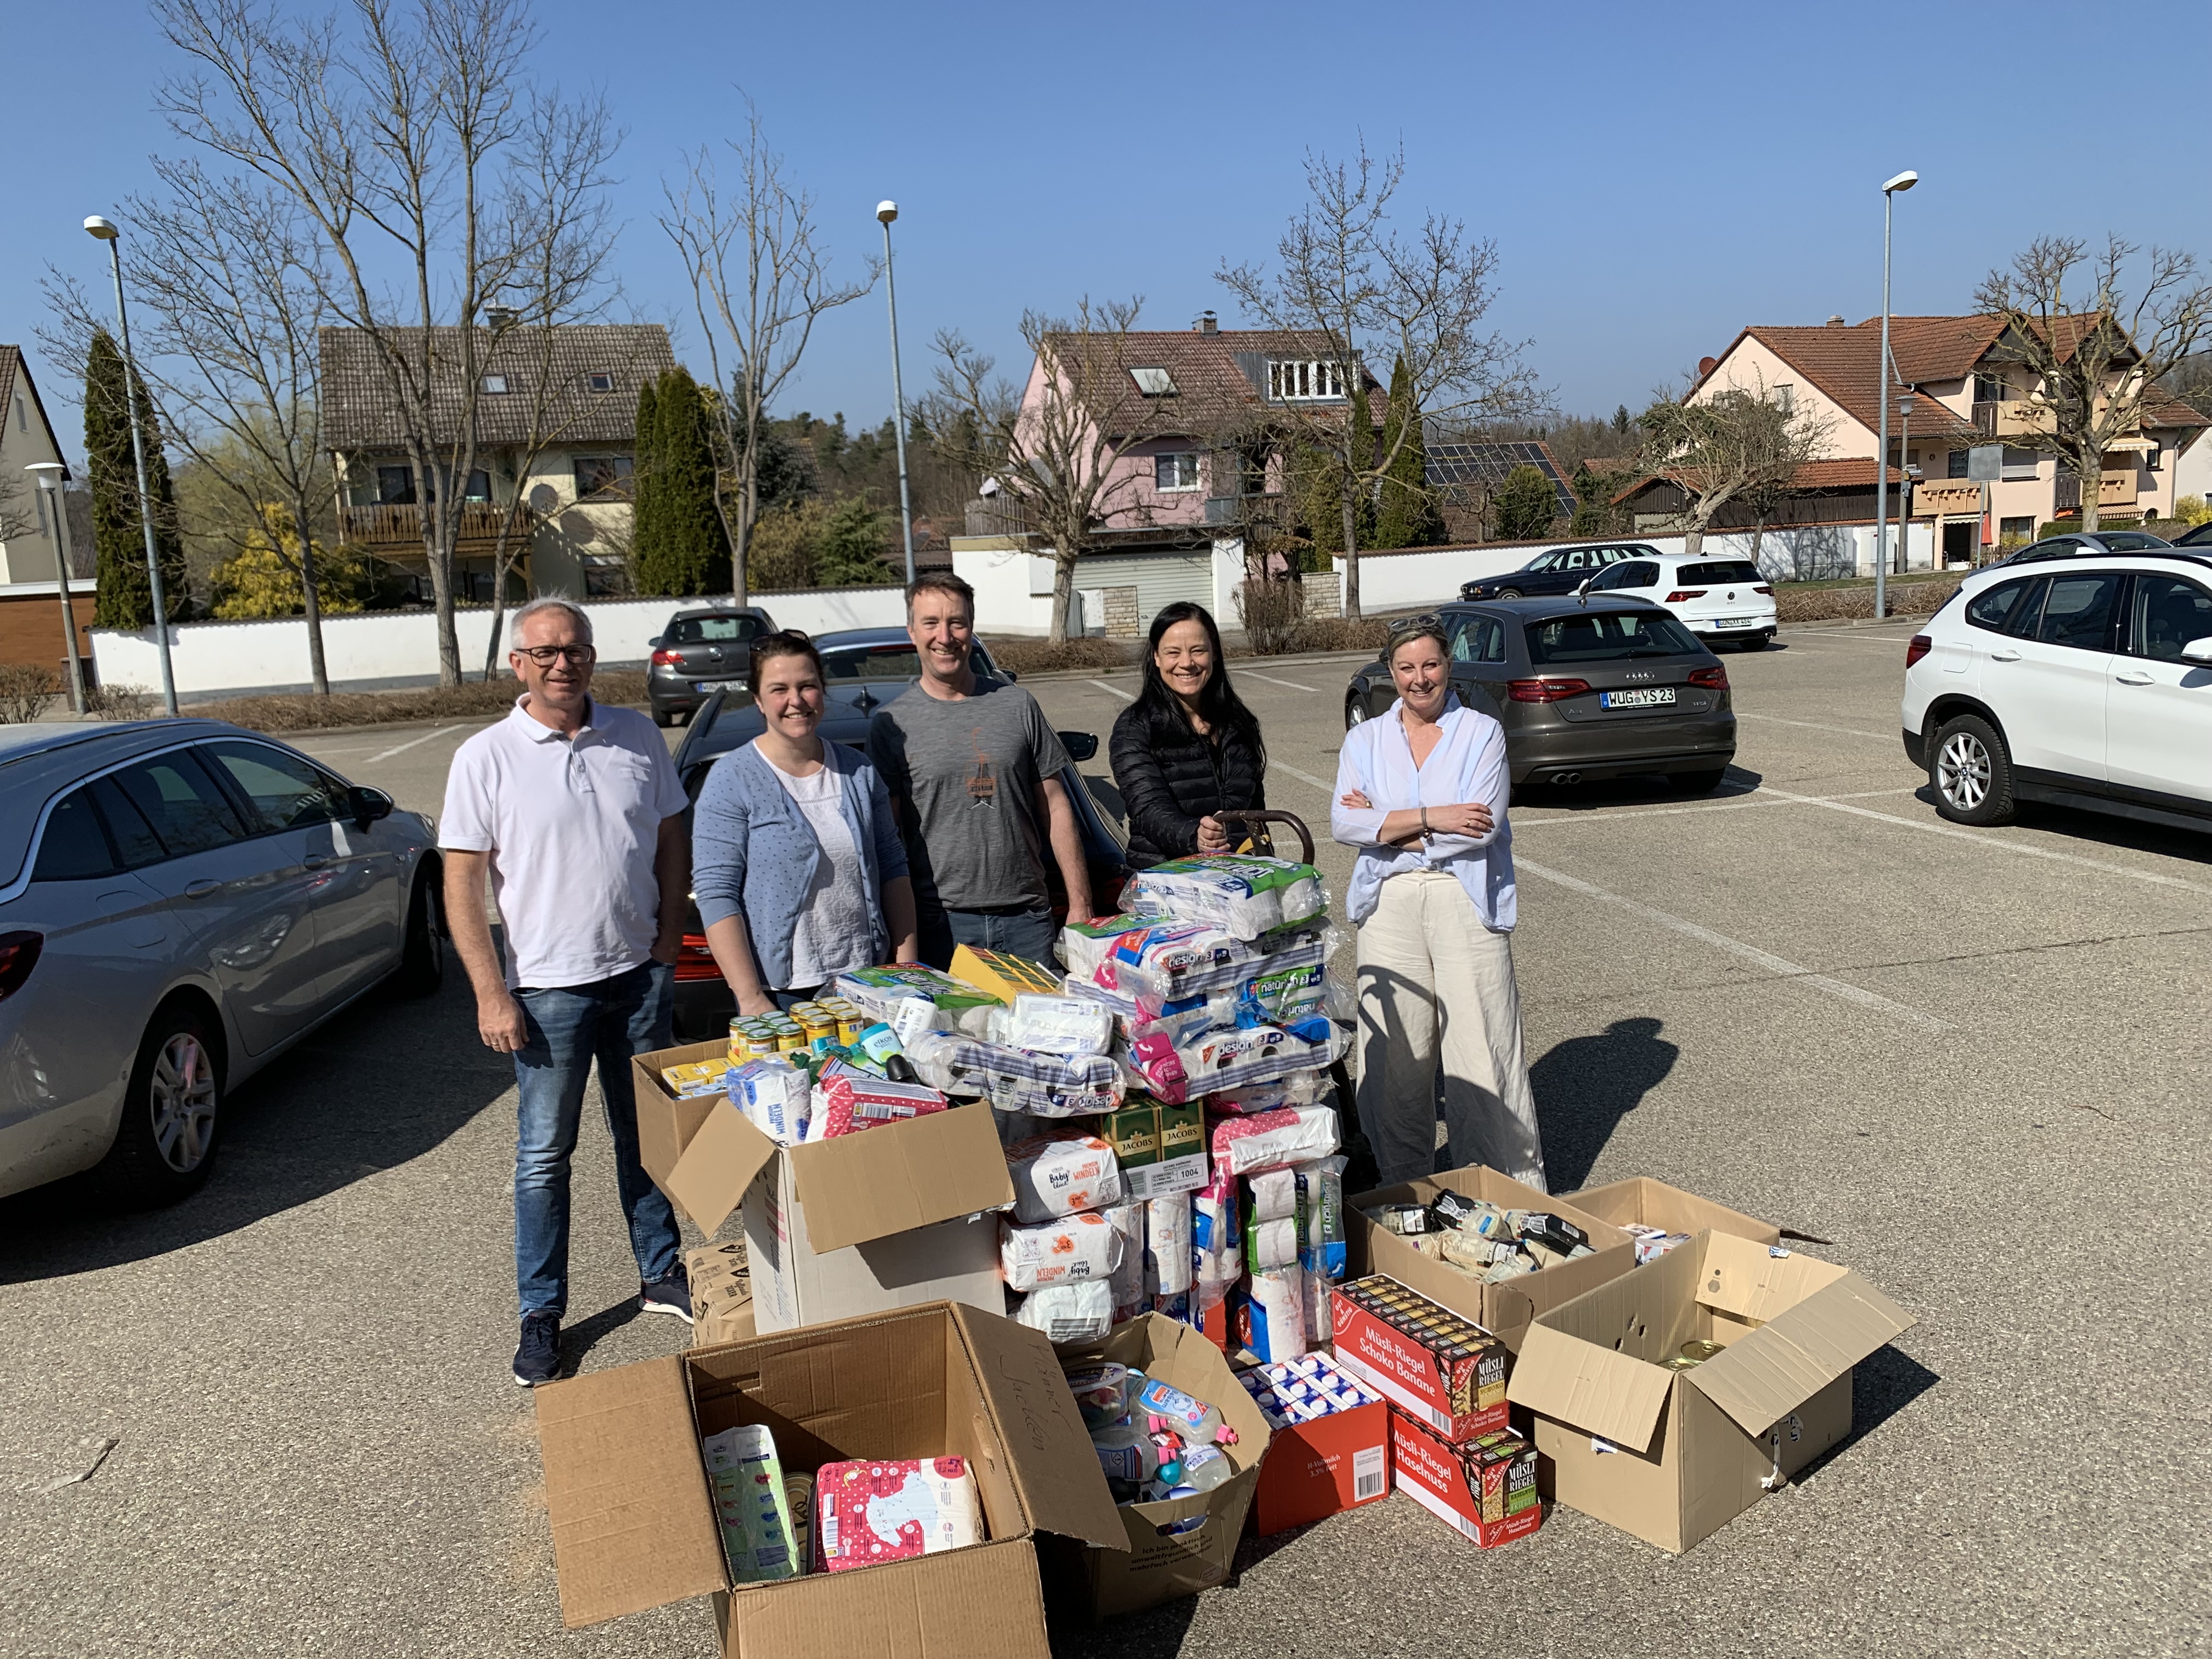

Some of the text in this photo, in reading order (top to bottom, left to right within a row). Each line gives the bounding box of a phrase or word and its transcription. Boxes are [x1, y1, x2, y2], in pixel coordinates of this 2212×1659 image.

[1609, 689, 1674, 705] WUG YS 23
[1169, 952, 1203, 968] design
[874, 1035, 893, 1047] elkos
[1217, 1040, 1254, 1056] design
[1167, 1128, 1197, 1141] JACOBS
[1122, 1138, 1153, 1152] JACOBS
[1082, 1161, 1098, 1169] PREMIUM
[1181, 1168, 1199, 1178] 1004
[1049, 1171, 1069, 1183] Baby
[1073, 1166, 1100, 1181] WINDELN
[1037, 1266, 1065, 1277] WINDELN
[1070, 1266, 1090, 1275] Baby
[1335, 1299, 1343, 1311] GUT
[1338, 1306, 1353, 1328] GÜNSTIG
[1365, 1325, 1426, 1375] Müsli-Riegel
[1359, 1338, 1395, 1370] Schoko
[1396, 1359, 1436, 1397] Banane
[1456, 1362, 1465, 1374] GUT
[1458, 1359, 1475, 1385] GÜNSTIG
[1479, 1356, 1504, 1376] MÜSLI
[1479, 1369, 1505, 1387] RIEGEL
[1307, 1454, 1341, 1470] H-Vollmilch
[1326, 1463, 1338, 1472] Fett
[1396, 1445, 1448, 1494] Haselnuss
[1486, 1467, 1496, 1481] GUT
[1488, 1465, 1505, 1491] GÜNSTIG
[1509, 1460, 1536, 1482] MÜSLI
[1509, 1476, 1536, 1492] RIEGEL
[1506, 1514, 1535, 1530] Müsli-Riegel
[1509, 1522, 1532, 1535] Haselnuss
[1131, 1536, 1213, 1564] umweltfreundlich und
[1170, 1534, 1206, 1550] praktisch
[1129, 1560, 1168, 1572] mehrfach
